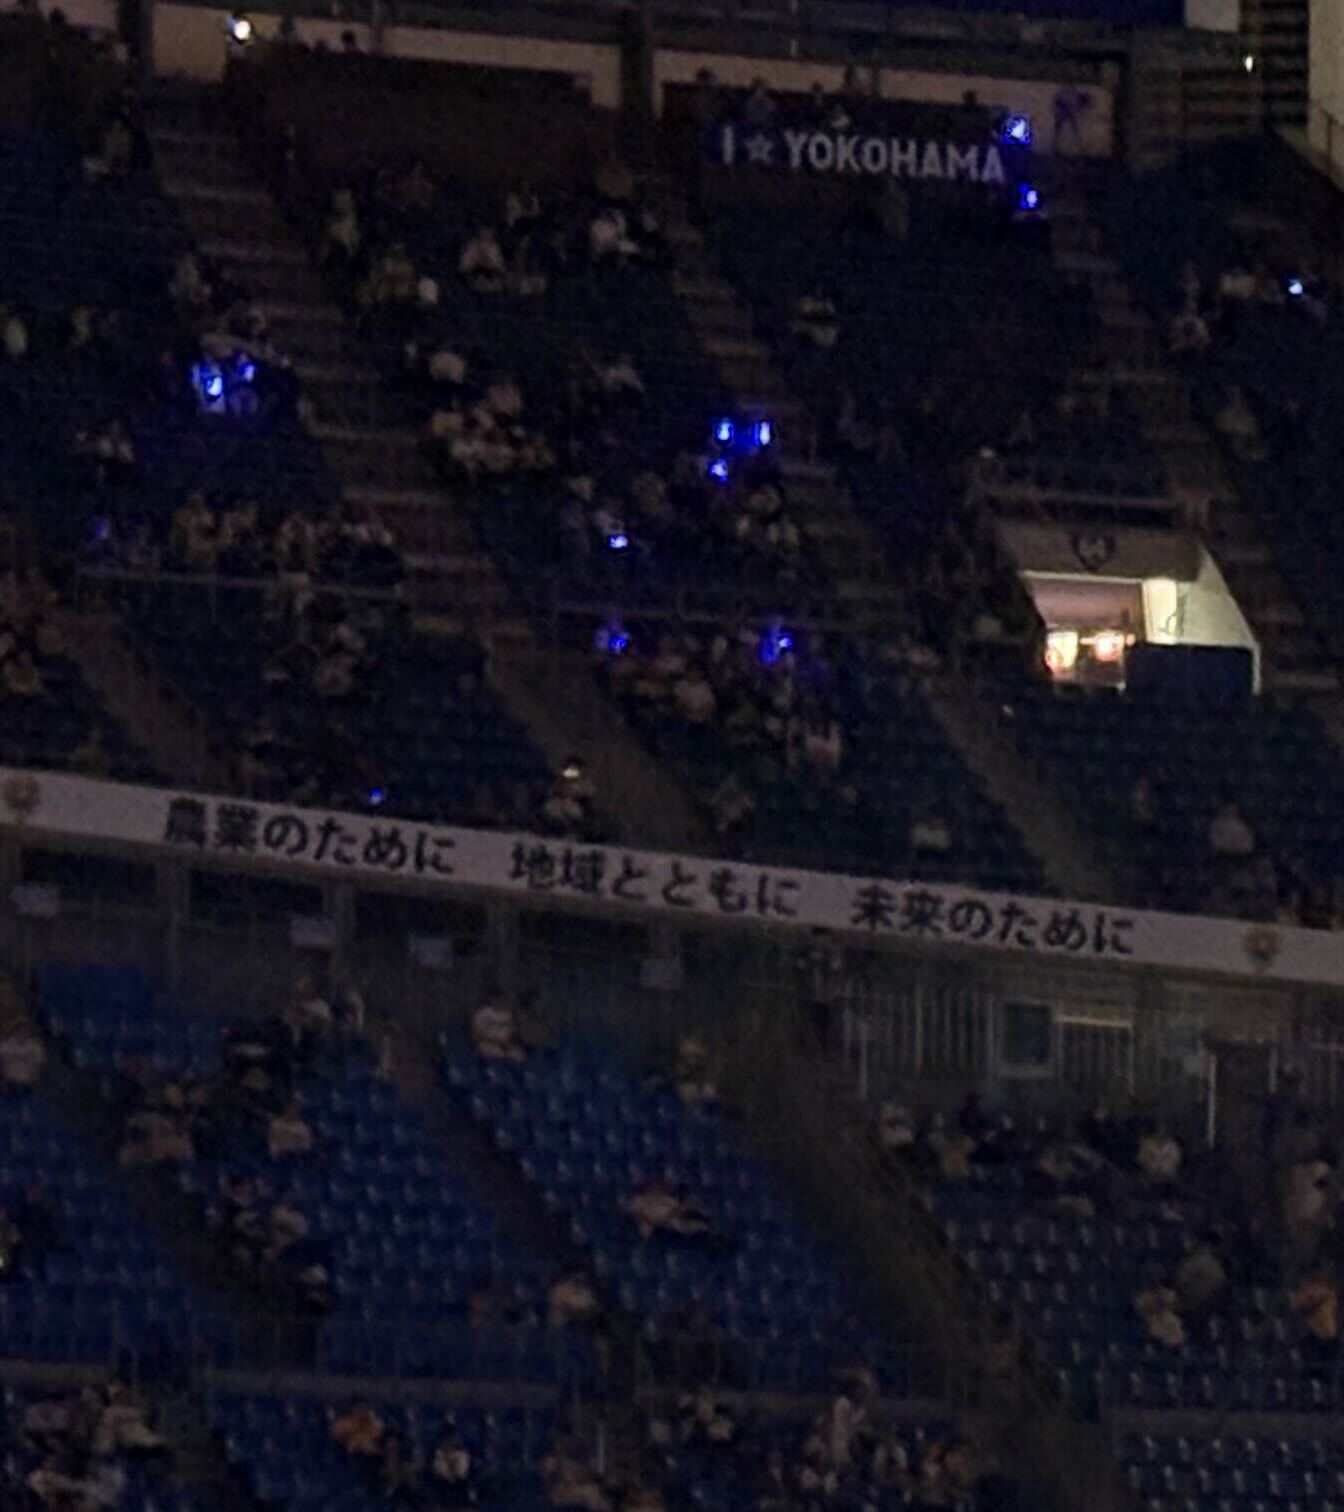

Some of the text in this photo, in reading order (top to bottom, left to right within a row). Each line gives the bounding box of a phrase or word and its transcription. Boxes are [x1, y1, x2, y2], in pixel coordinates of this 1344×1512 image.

[783, 128, 1005, 184] YOKOHAMA
[164, 797, 456, 875] 農業のために
[508, 845, 803, 918] 地域とともに
[850, 883, 1136, 955] 未来のために
